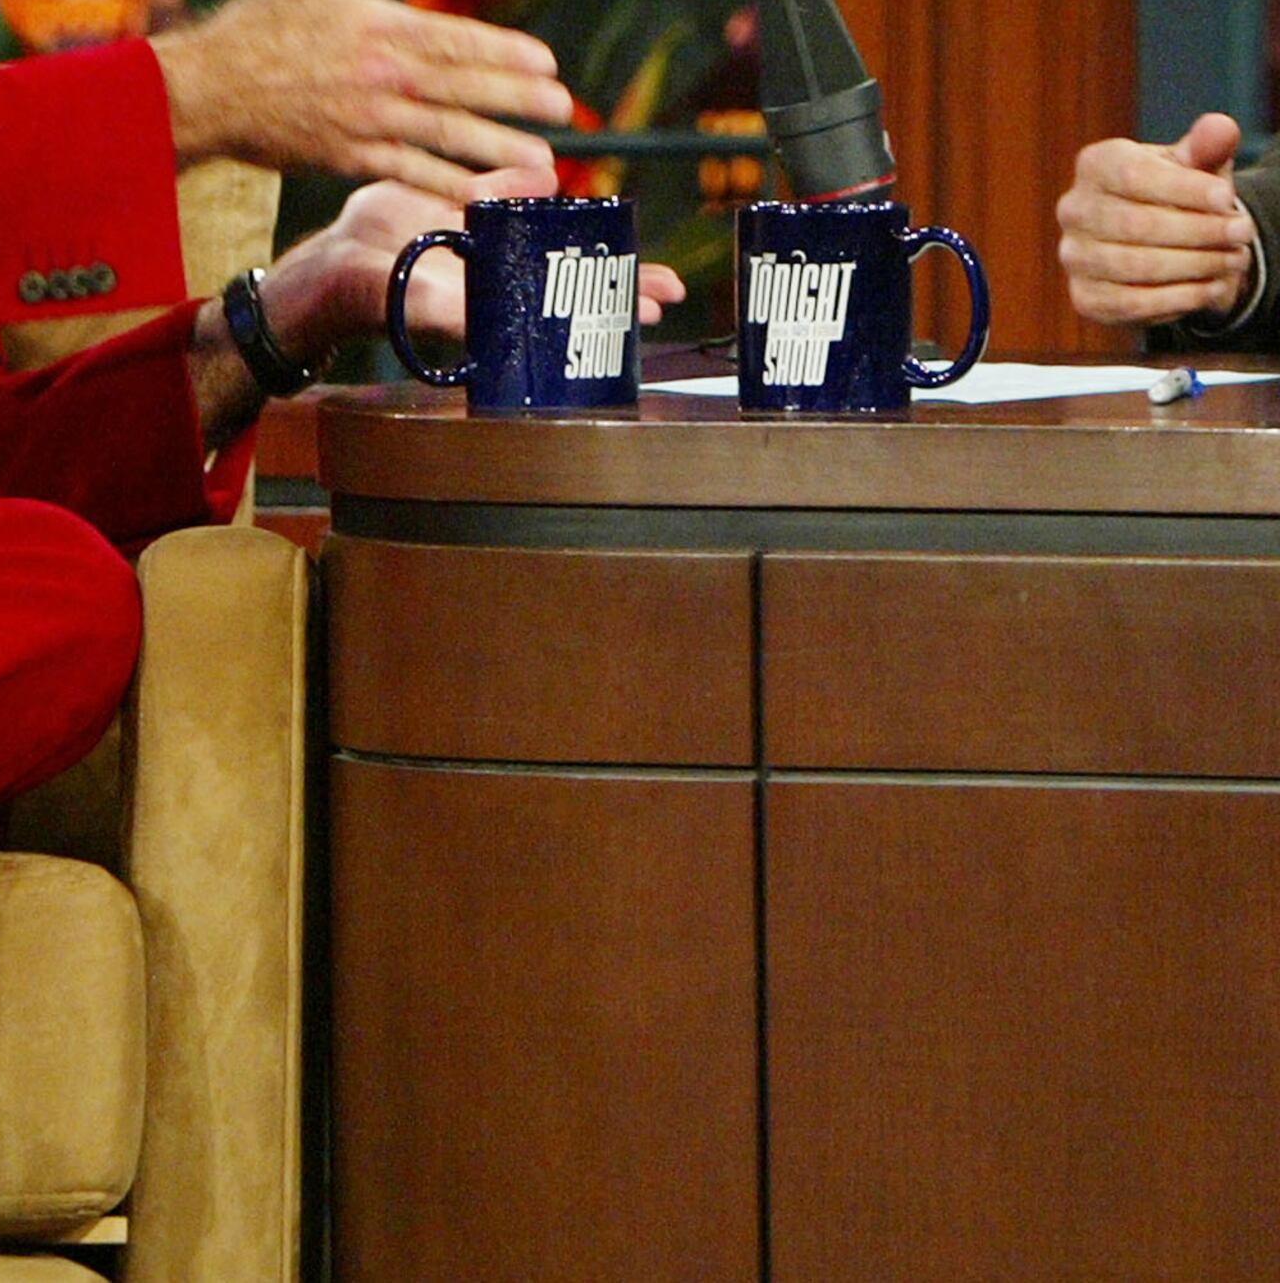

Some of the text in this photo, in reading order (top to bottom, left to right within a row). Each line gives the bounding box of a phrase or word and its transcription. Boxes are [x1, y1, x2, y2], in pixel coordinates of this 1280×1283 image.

[542, 251, 636, 319] TONIGHT
[747, 257, 856, 324] TONIGHT
[563, 331, 626, 379] SHOW
[761, 339, 831, 386] SHOW
